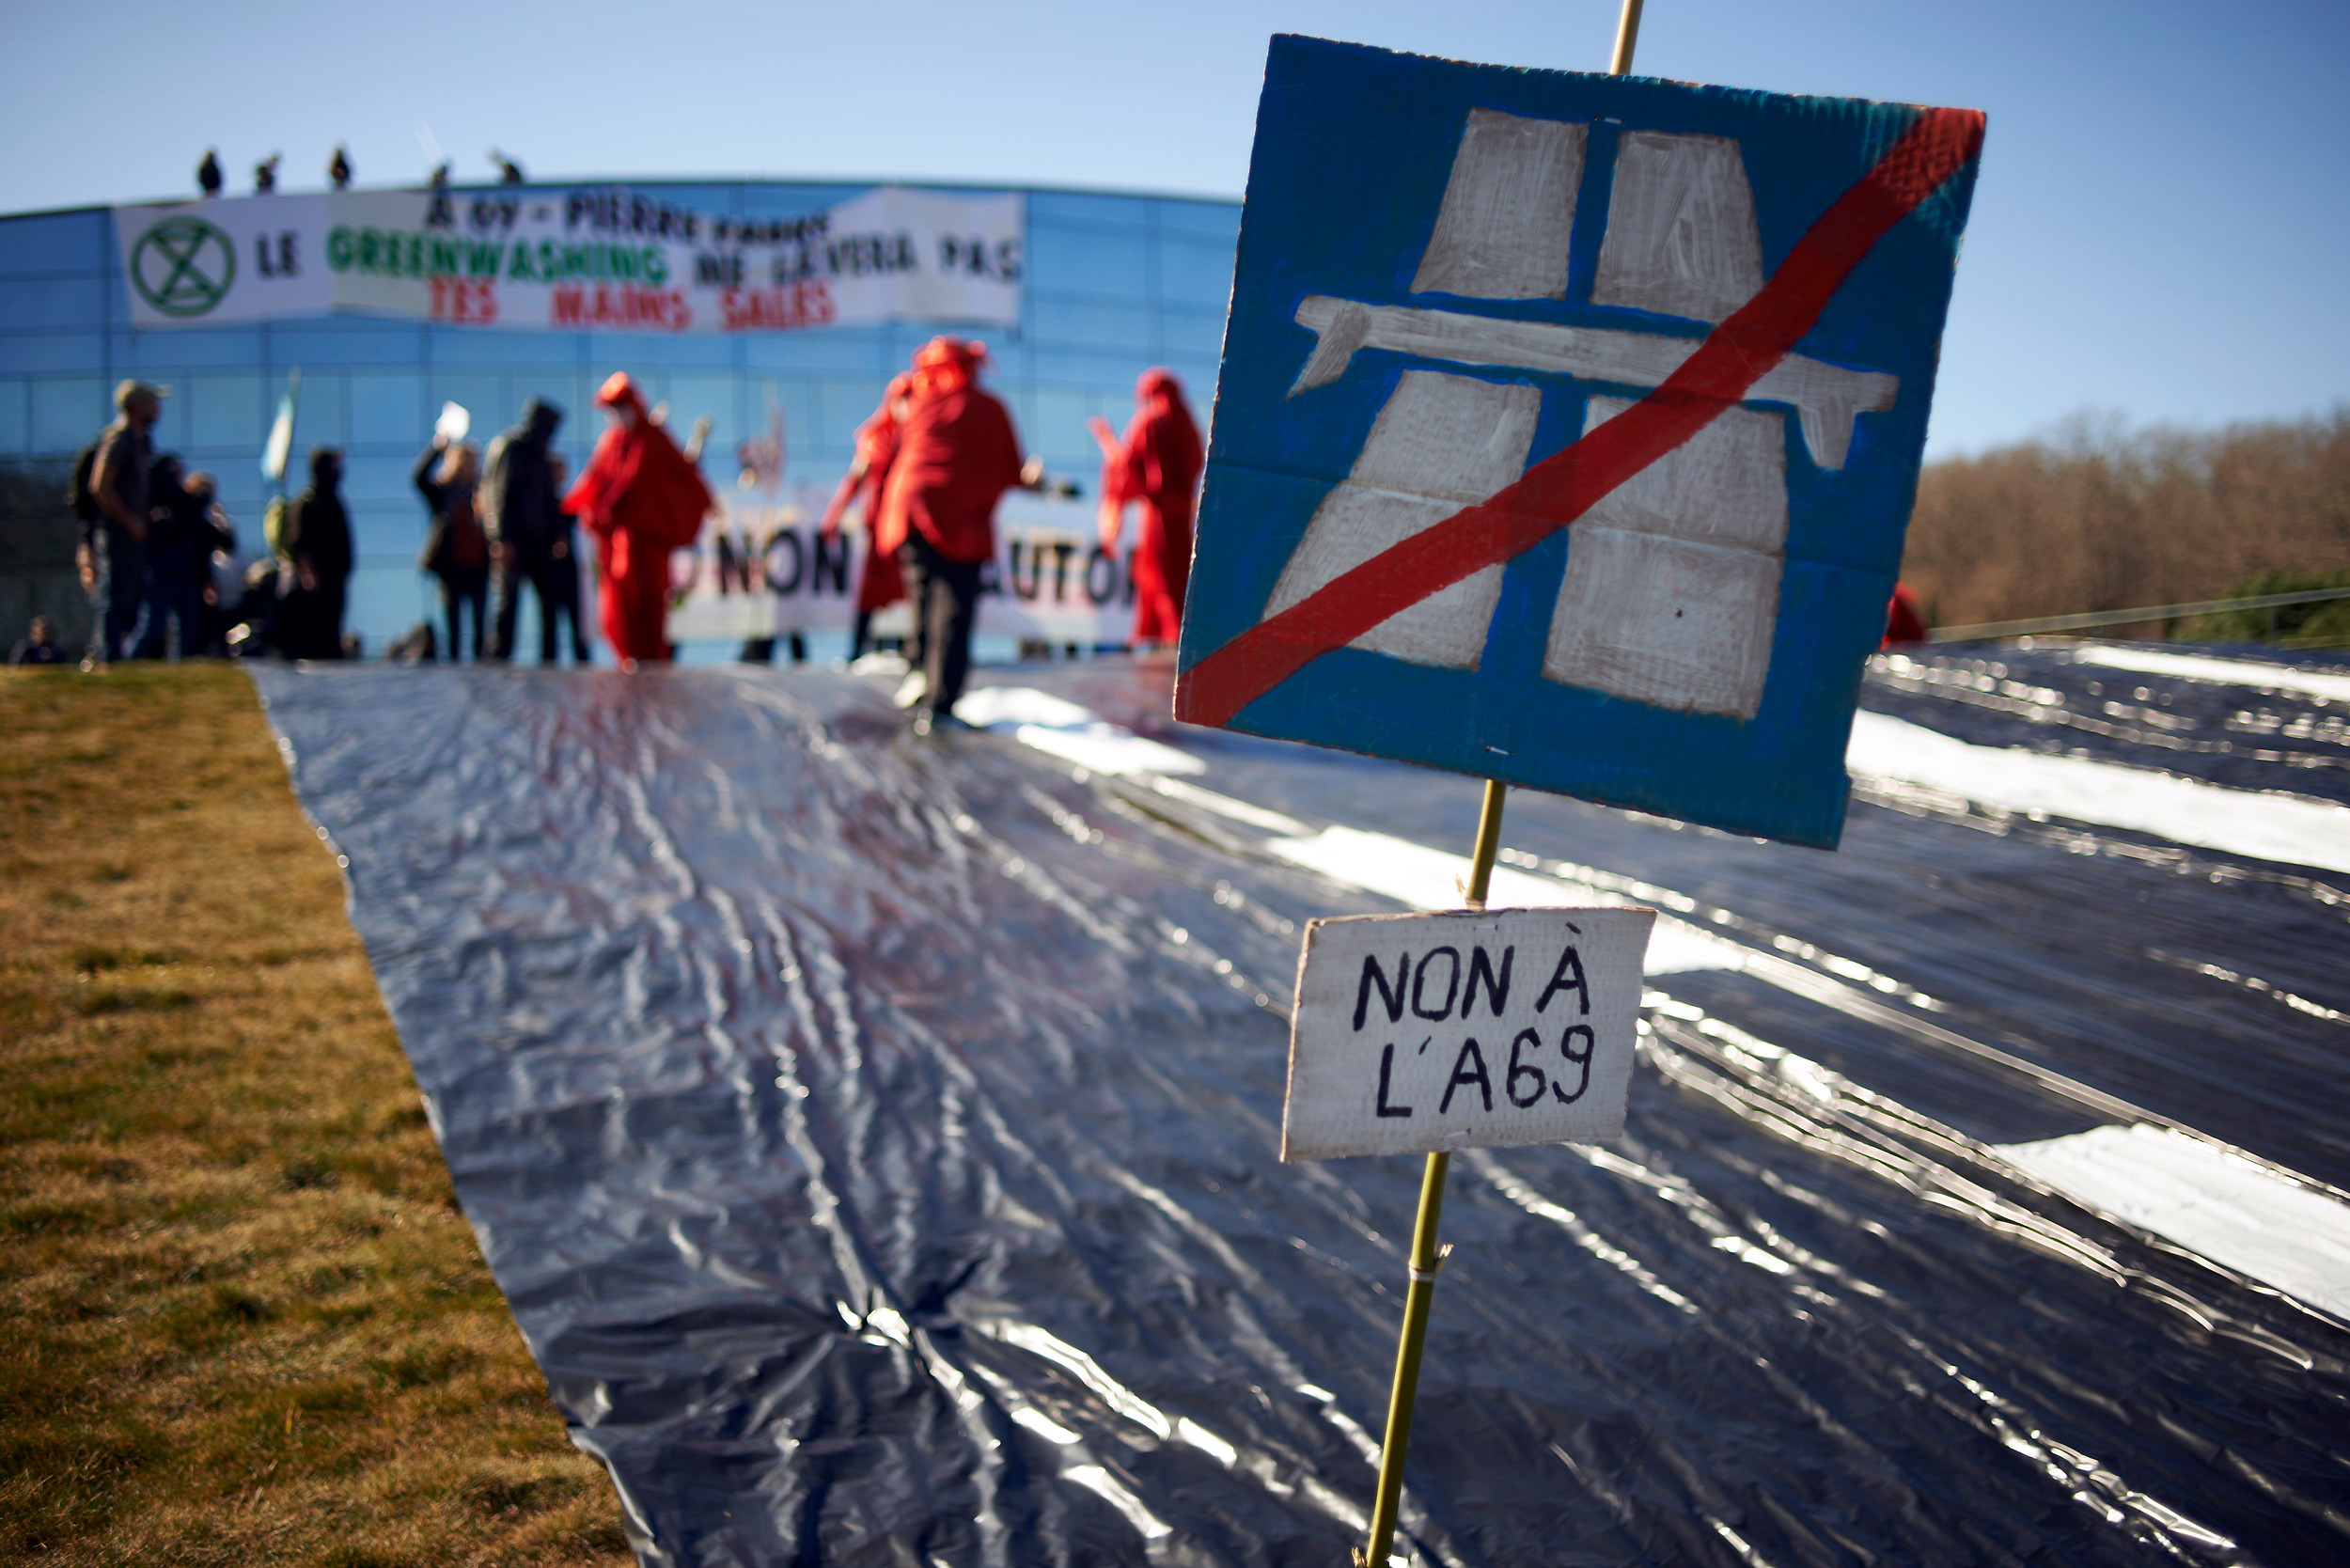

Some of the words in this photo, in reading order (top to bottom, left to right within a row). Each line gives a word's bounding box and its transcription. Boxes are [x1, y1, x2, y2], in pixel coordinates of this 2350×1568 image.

[566, 188, 698, 243] PIERRE
[257, 230, 302, 277] LE
[326, 225, 667, 286] GREENWASHING
[694, 250, 744, 290] NE
[943, 235, 1023, 281] PAS
[426, 276, 499, 326] TES
[551, 286, 691, 333] MAINS
[720, 283, 838, 333] SALES
[715, 528, 852, 597] NON
[983, 538, 1136, 607] UTO
[1352, 945, 1515, 1032] NON
[1534, 921, 1590, 1015] À
[1376, 1023, 1595, 1119] L'A69
